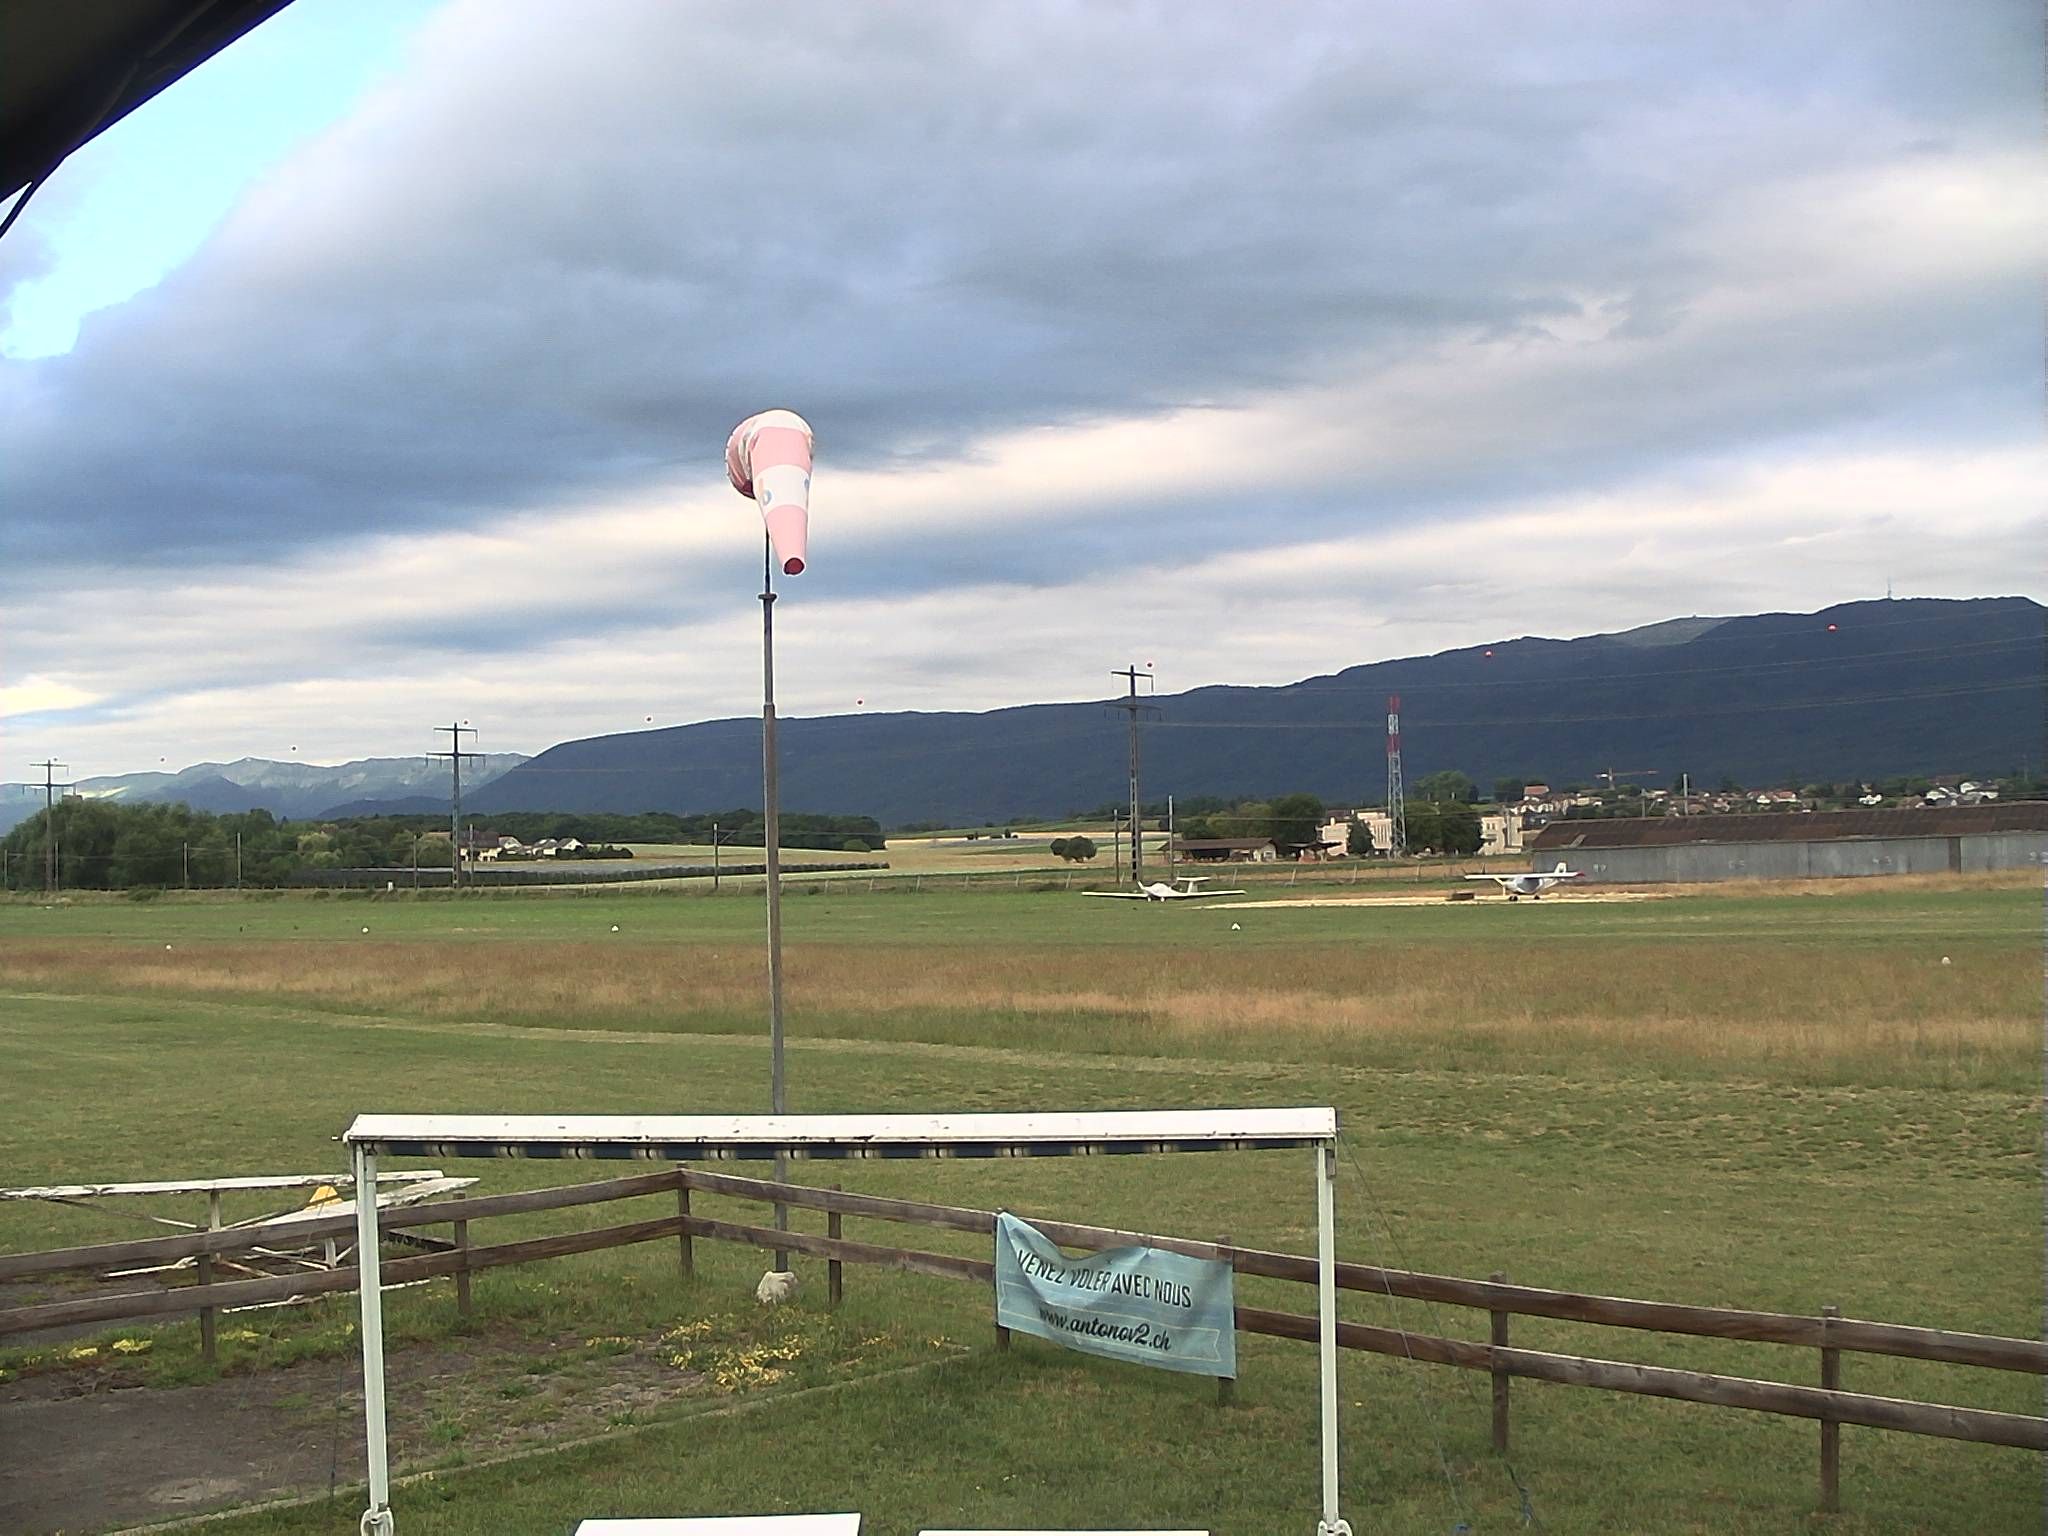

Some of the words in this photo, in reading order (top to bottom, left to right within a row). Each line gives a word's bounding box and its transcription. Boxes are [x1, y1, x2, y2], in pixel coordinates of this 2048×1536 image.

[1018, 1250, 1065, 1283] VENEZ
[1070, 1269, 1111, 1291] VOLER
[1112, 1273, 1150, 1297] AVEC
[1155, 1279, 1191, 1307] NOUS
